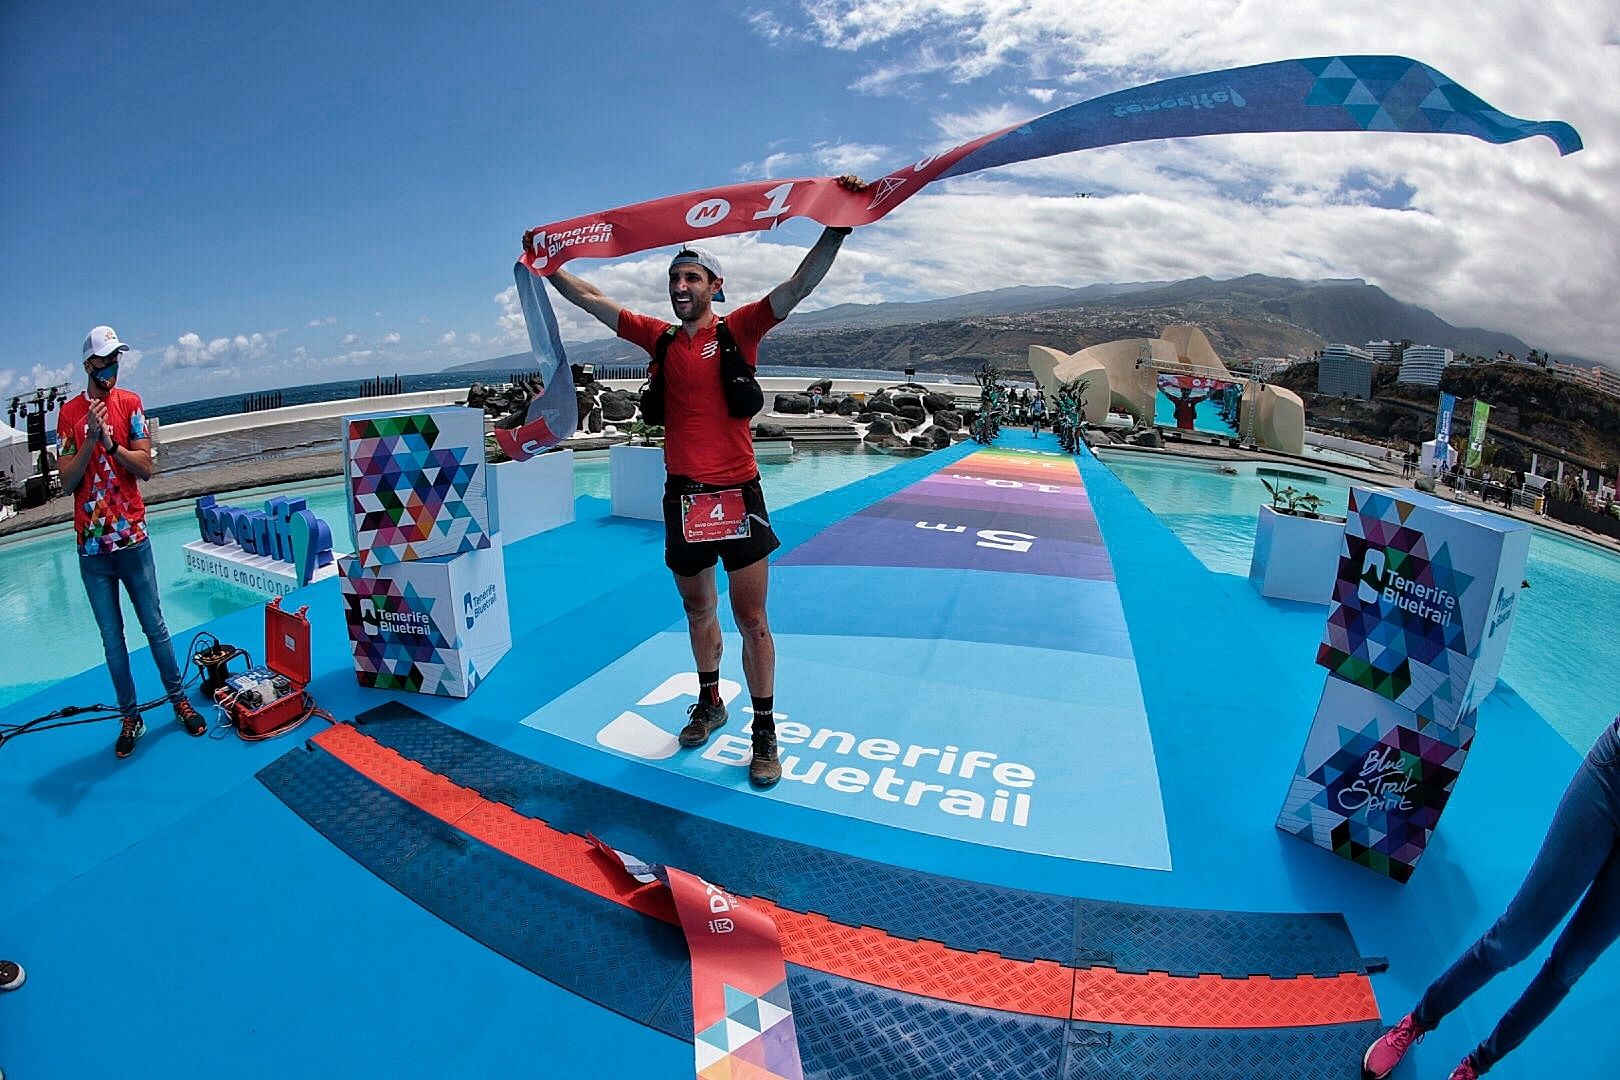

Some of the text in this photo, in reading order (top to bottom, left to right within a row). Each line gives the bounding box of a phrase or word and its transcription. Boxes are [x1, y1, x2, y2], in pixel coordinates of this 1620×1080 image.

[694, 204, 722, 221] M
[547, 222, 613, 245] Tenerife
[549, 232, 611, 257] Bluetrail
[710, 503, 725, 521] 4
[976, 529, 1037, 552] 5
[186, 554, 229, 578] despierta
[473, 583, 496, 607] Tenerife
[1386, 569, 1456, 610] Tenerife
[378, 609, 430, 624] Tenerife
[474, 594, 497, 619] Bluetrail
[1383, 587, 1452, 627] Bluetrail
[380, 620, 431, 636] Bluetrail
[1359, 746, 1406, 777] Blue
[701, 734, 1032, 828] Buetrail
[1369, 768, 1417, 795] Trail
[1337, 780, 1414, 818] Spirit
